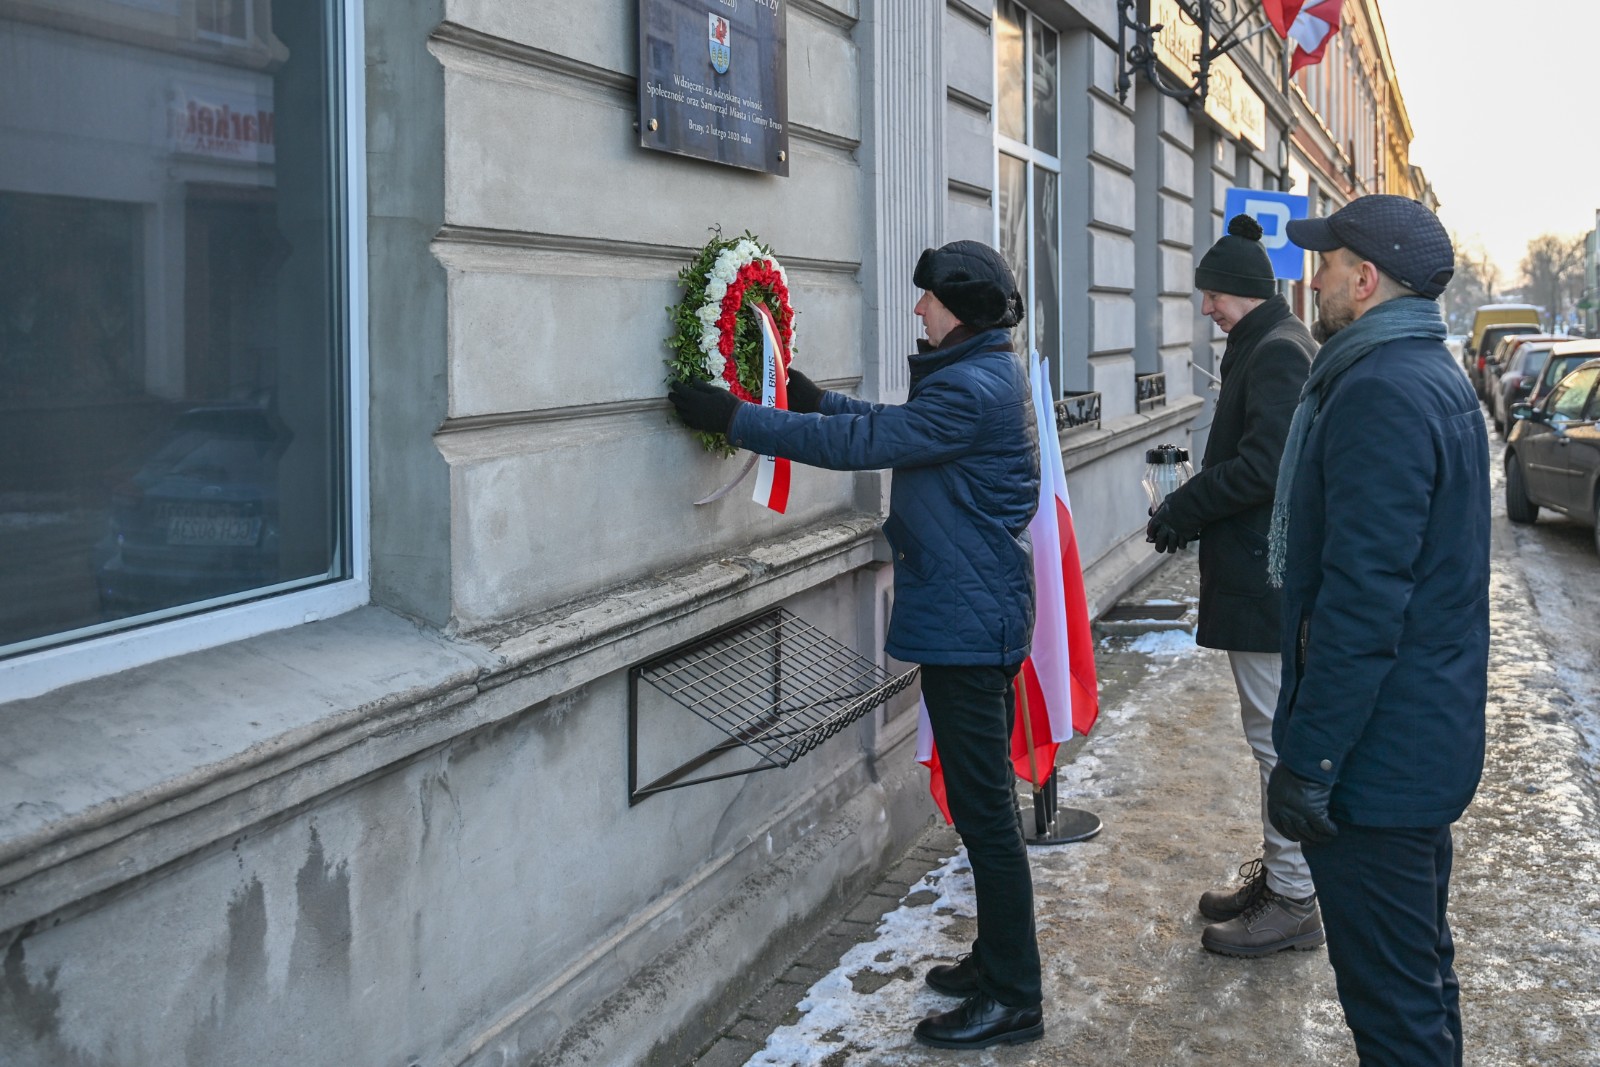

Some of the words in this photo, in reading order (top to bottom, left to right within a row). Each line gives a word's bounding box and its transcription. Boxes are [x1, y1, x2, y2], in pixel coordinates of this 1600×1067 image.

[646, 81, 685, 103] Społeczność
[686, 96, 699, 107] oraz
[700, 98, 728, 118] Samorząd
[729, 105, 747, 120] Miasta
[751, 113, 768, 130] Gminy
[769, 118, 783, 133] Brusy
[673, 73, 704, 93] Wdzięczni
[705, 87, 712, 95] za
[714, 87, 741, 107] odzyskaną
[742, 97, 763, 111] wolność
[688, 119, 704, 135] Brusy,
[706, 124, 710, 134] 2
[710, 123, 727, 140] lutego
[727, 130, 740, 141] 2020
[740, 132, 752, 144] roku
